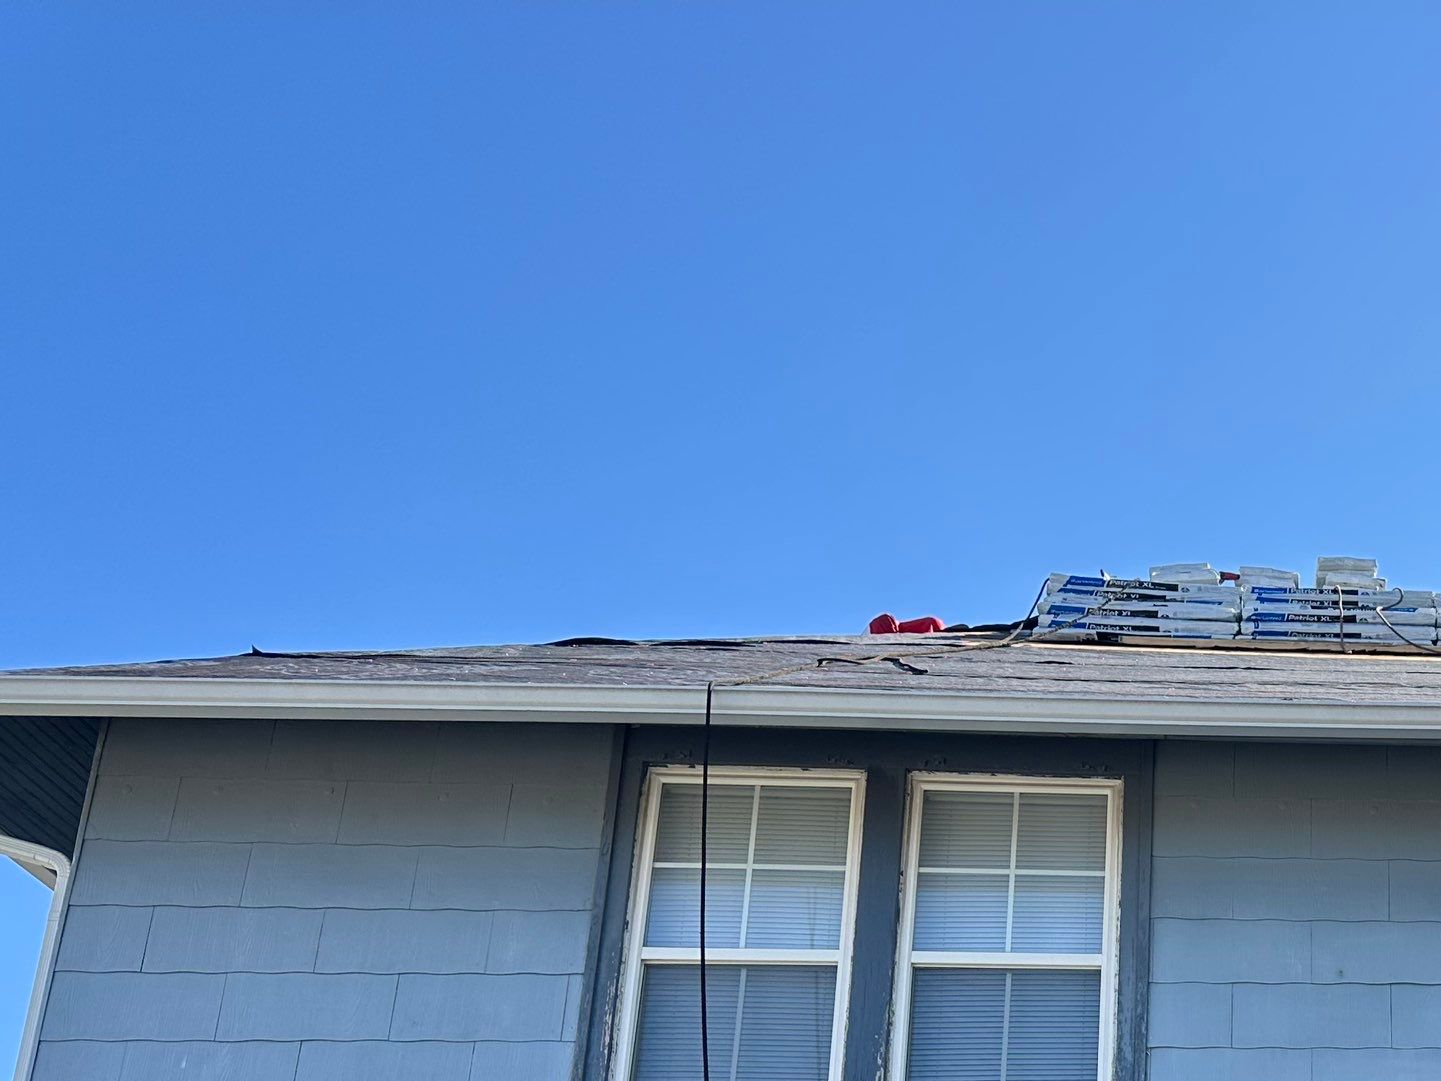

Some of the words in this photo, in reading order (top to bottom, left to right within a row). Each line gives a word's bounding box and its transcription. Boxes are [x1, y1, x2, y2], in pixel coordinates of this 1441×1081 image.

[1110, 579, 1139, 588] Patrot
[1142, 581, 1153, 589] XL
[1289, 614, 1318, 622] Patriot
